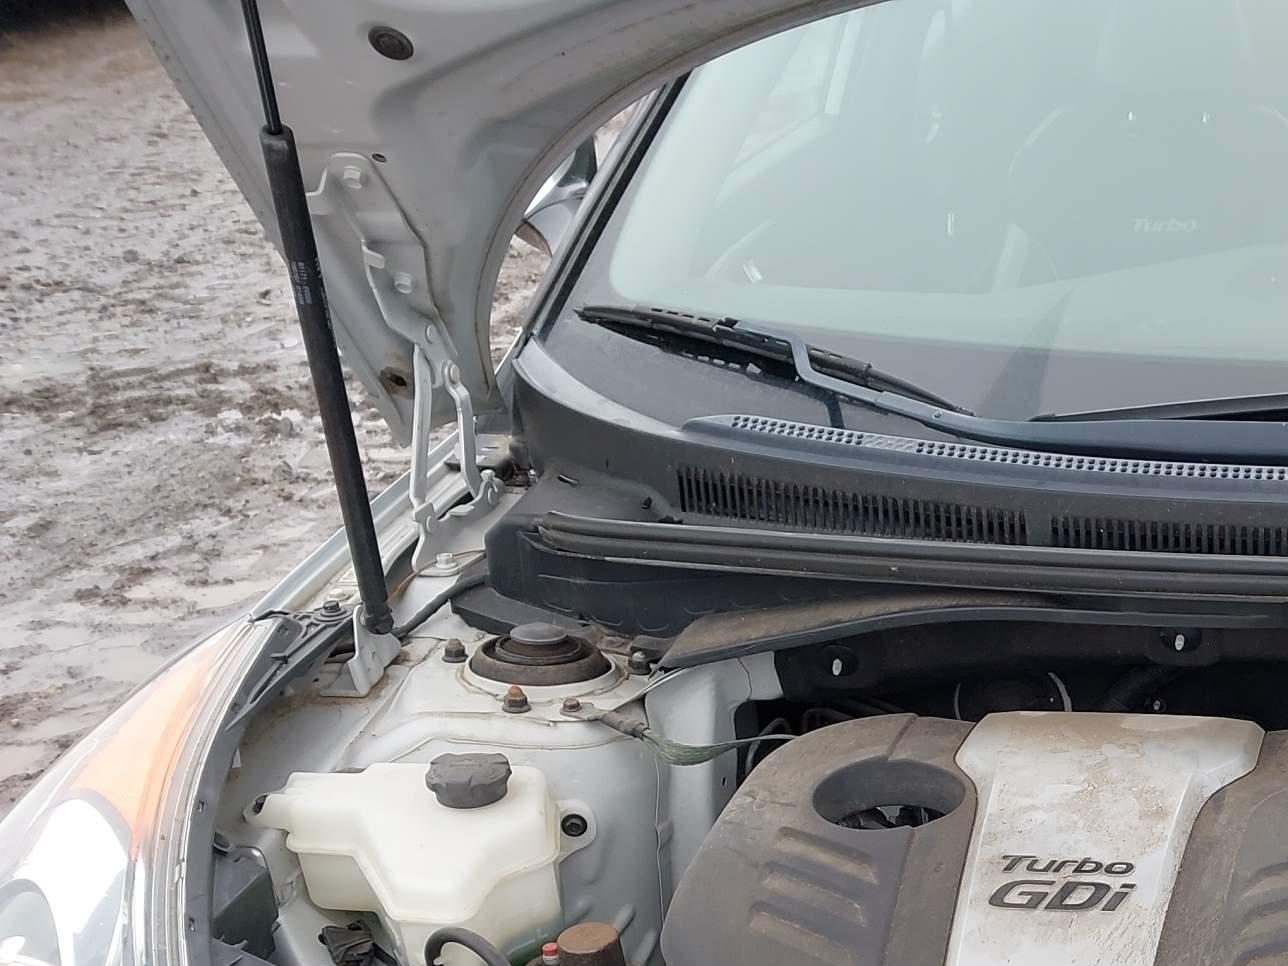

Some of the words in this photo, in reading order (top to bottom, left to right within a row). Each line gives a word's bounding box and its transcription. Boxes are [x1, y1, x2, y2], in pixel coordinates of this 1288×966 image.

[1132, 217, 1198, 233] Turbo
[1002, 855, 1136, 875] Turbo
[988, 879, 1137, 912] GDi
